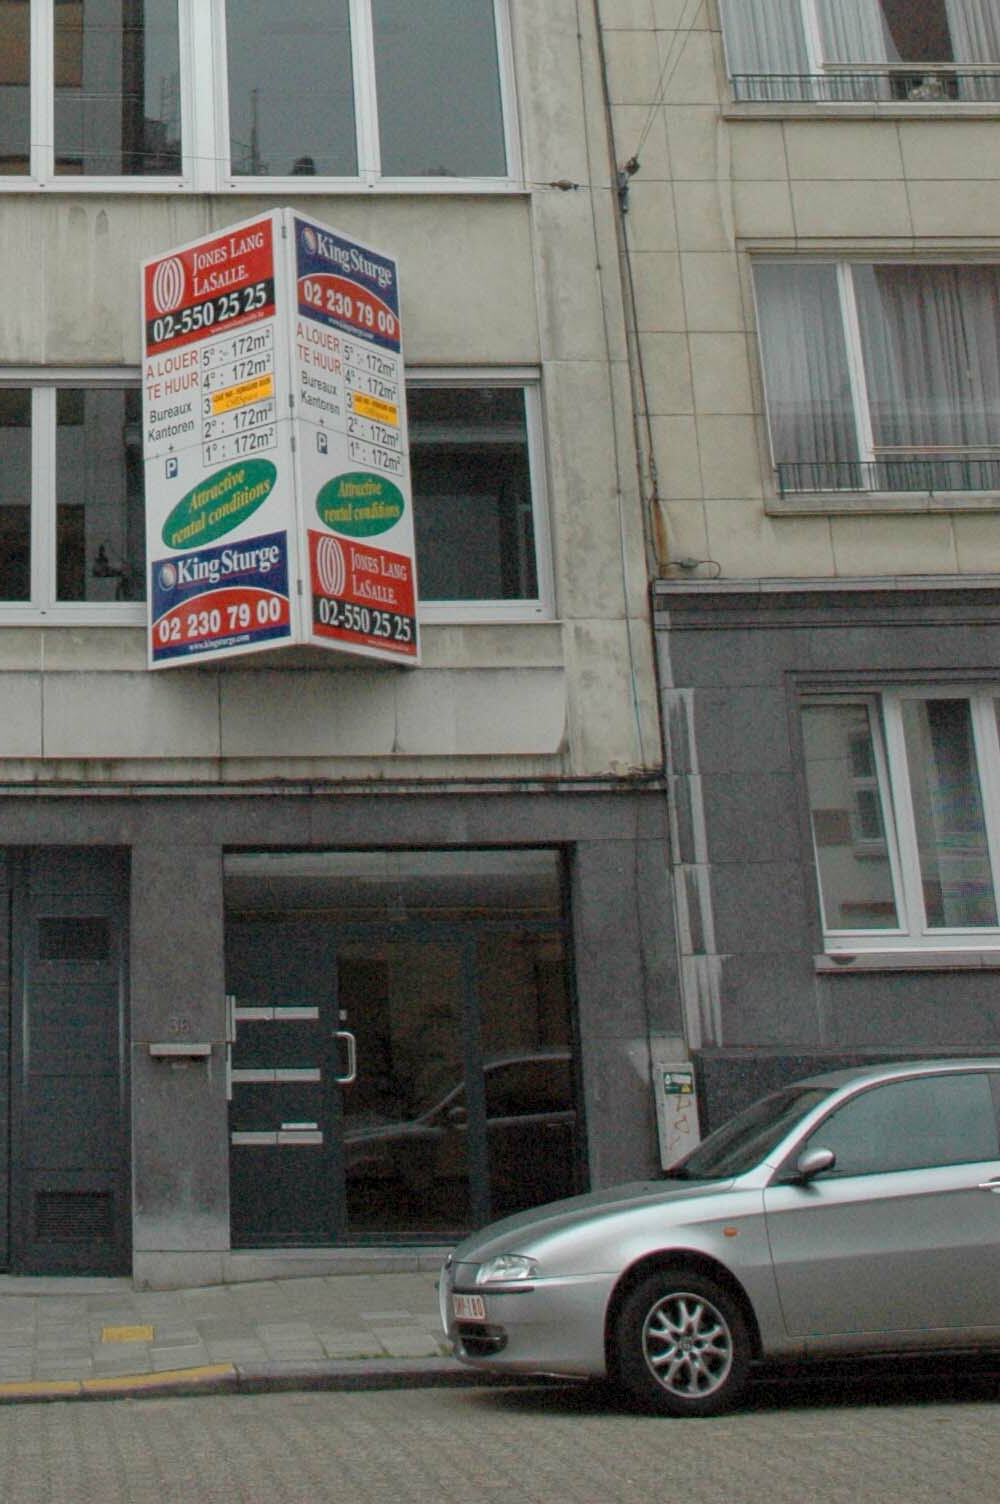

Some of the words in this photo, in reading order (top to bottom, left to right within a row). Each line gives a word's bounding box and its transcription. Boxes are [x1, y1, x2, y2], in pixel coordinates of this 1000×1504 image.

[192, 246, 227, 277] JONES
[230, 232, 264, 258] LANG
[153, 302, 214, 342] 02-550
[218, 293, 240, 321] 25
[244, 283, 267, 312] 25
[304, 280, 322, 306] 02
[326, 288, 352, 318] 230
[355, 301, 374, 327] 79
[378, 310, 395, 335] 00
[297, 322, 304, 337] A
[306, 327, 340, 353] LOUER
[146, 365, 155, 381] A
[157, 349, 199, 376] LOUER
[297, 344, 310, 364] TE
[313, 351, 341, 375] HUUR
[146, 385, 161, 400] TE
[164, 372, 199, 396] HUUR
[301, 370, 337, 395] Bureaux
[150, 401, 192, 424] Bureaux
[301, 390, 341, 416] Kantoren
[148, 420, 194, 443] Kantoren
[189, 469, 245, 512] Attractive
[340, 478, 382, 497] Attractive
[171, 512, 206, 546] rental
[208, 479, 271, 525] conditions
[324, 504, 352, 522] rental
[354, 501, 399, 521] conditions
[351, 548, 379, 575] JONES
[380, 555, 408, 581] LANG
[159, 617, 181, 643] 02
[187, 609, 221, 638] 230
[227, 604, 250, 629] 79
[257, 597, 281, 624] 00
[319, 598, 371, 633] 02-550
[373, 611, 391, 637] 25
[394, 616, 412, 641] 25
